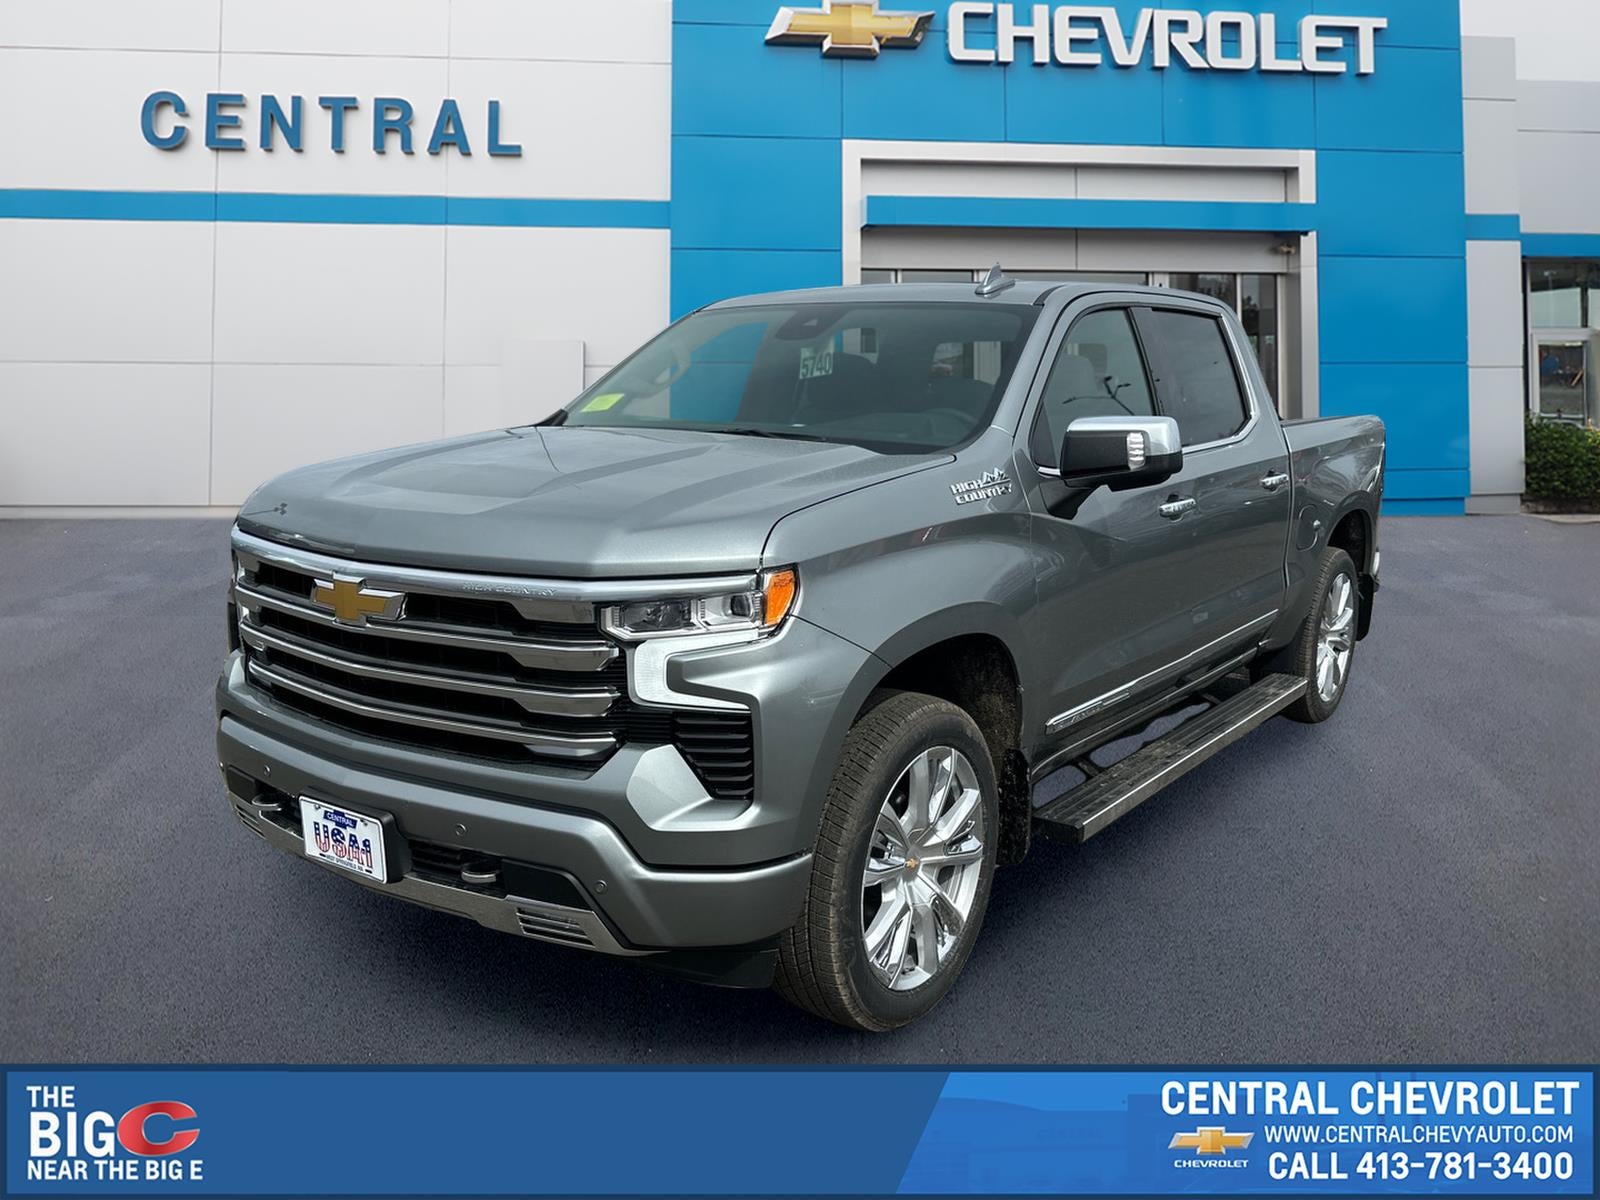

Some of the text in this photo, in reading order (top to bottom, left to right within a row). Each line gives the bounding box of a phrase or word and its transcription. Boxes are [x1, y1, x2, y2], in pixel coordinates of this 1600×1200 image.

[947, 1, 1388, 76] CHEVROLET
[140, 90, 522, 158] CENTRAL
[802, 352, 831, 377] 5740
[950, 479, 983, 494] HIGH
[955, 483, 1012, 505] COUNTRY
[326, 811, 354, 827] CENTRAL
